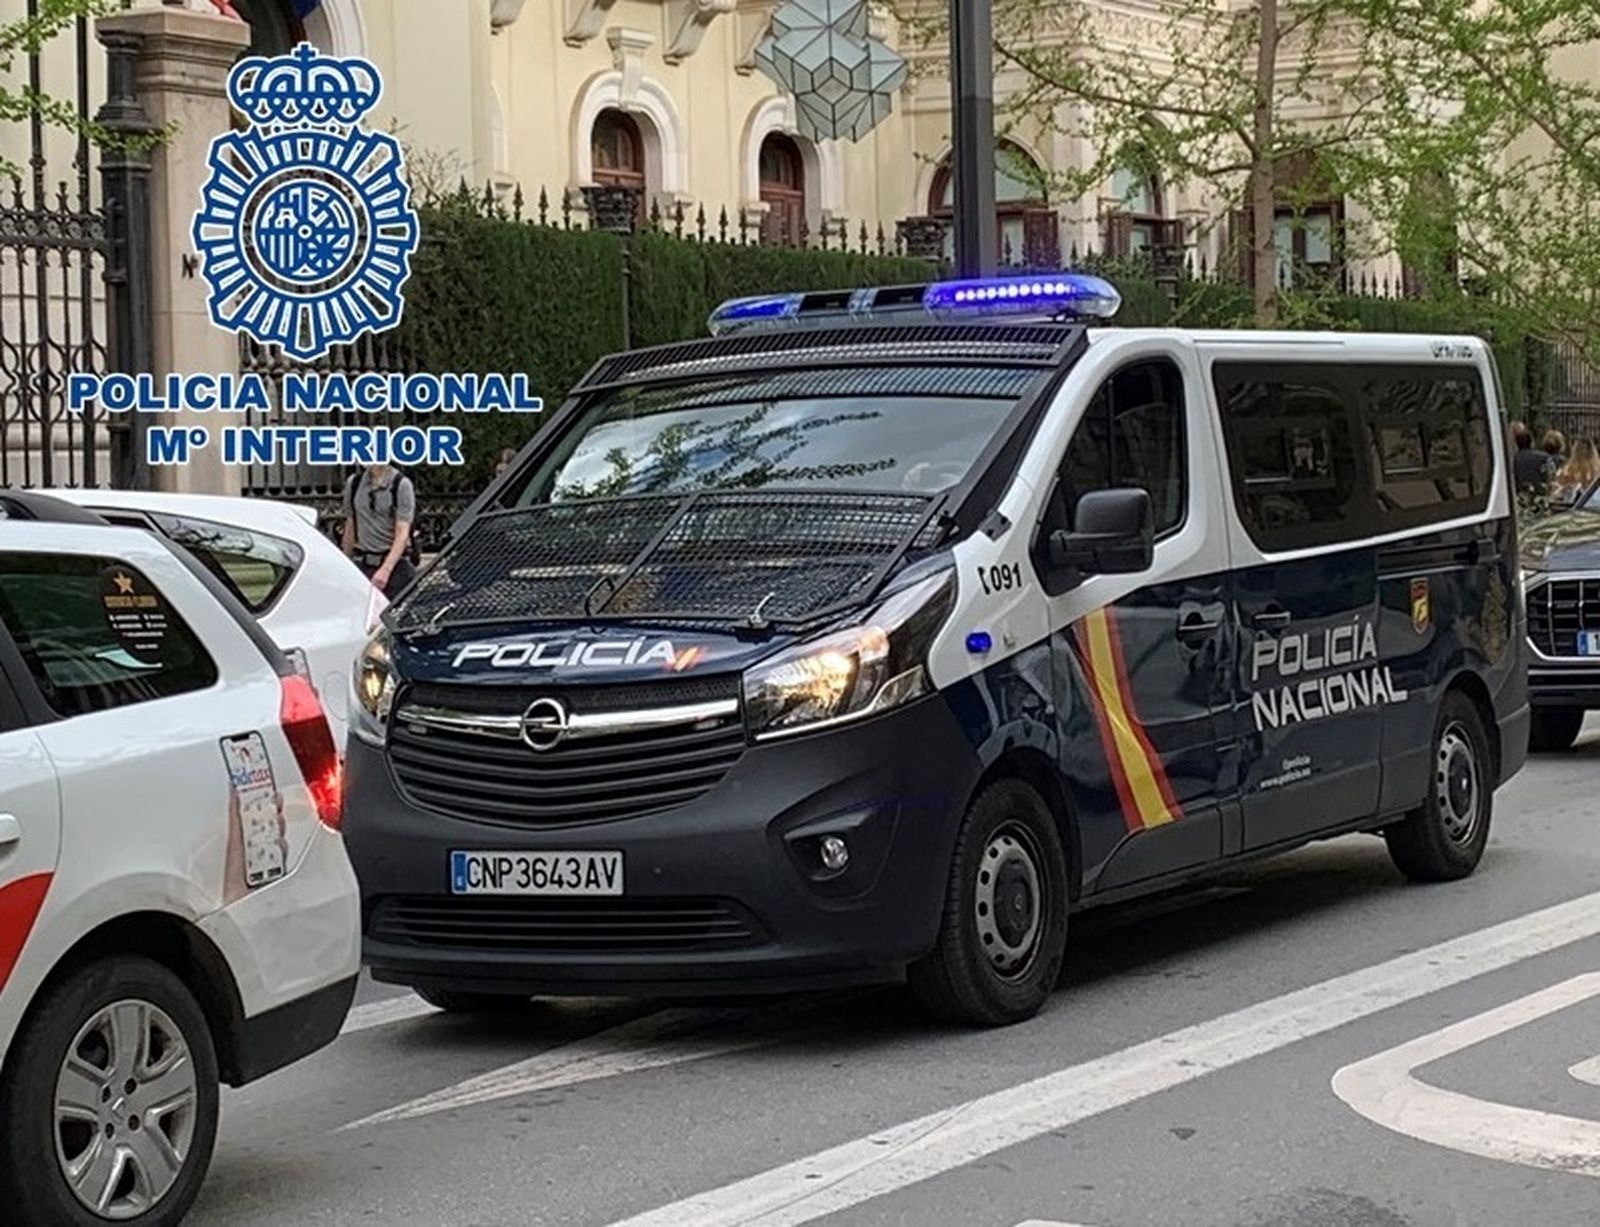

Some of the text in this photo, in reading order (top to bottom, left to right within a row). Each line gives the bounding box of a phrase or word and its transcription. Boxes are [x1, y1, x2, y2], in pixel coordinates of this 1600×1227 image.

[990, 562, 1022, 591] 091
[452, 636, 677, 668] POLICÍA
[1252, 614, 1377, 681] POLICÍA
[1252, 666, 1408, 731] NACIONAL
[466, 857, 617, 889] CNP3643AV
